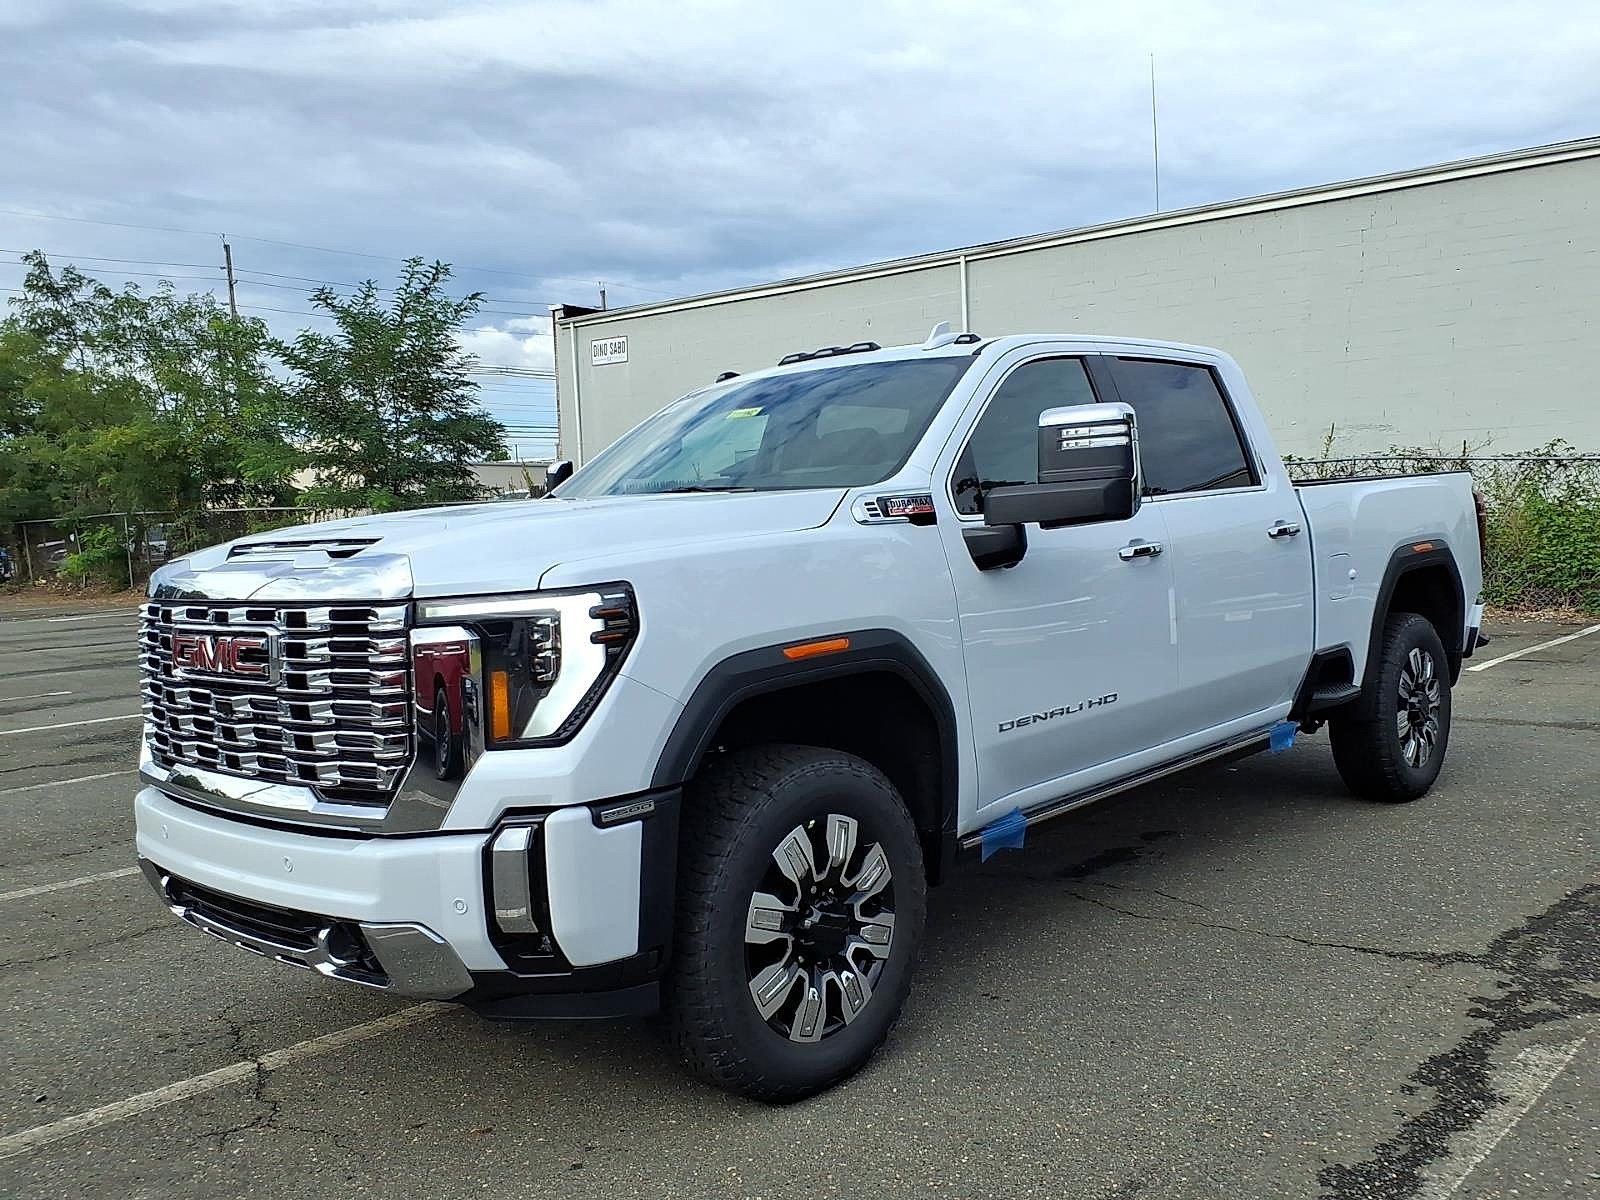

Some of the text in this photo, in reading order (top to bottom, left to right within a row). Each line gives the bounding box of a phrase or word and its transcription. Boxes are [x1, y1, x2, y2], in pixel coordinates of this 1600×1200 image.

[593, 343, 608, 357] DINO
[888, 497, 931, 509] DURAMAX
[173, 636, 268, 674] GMC
[998, 693, 1118, 733] DENALI HD
